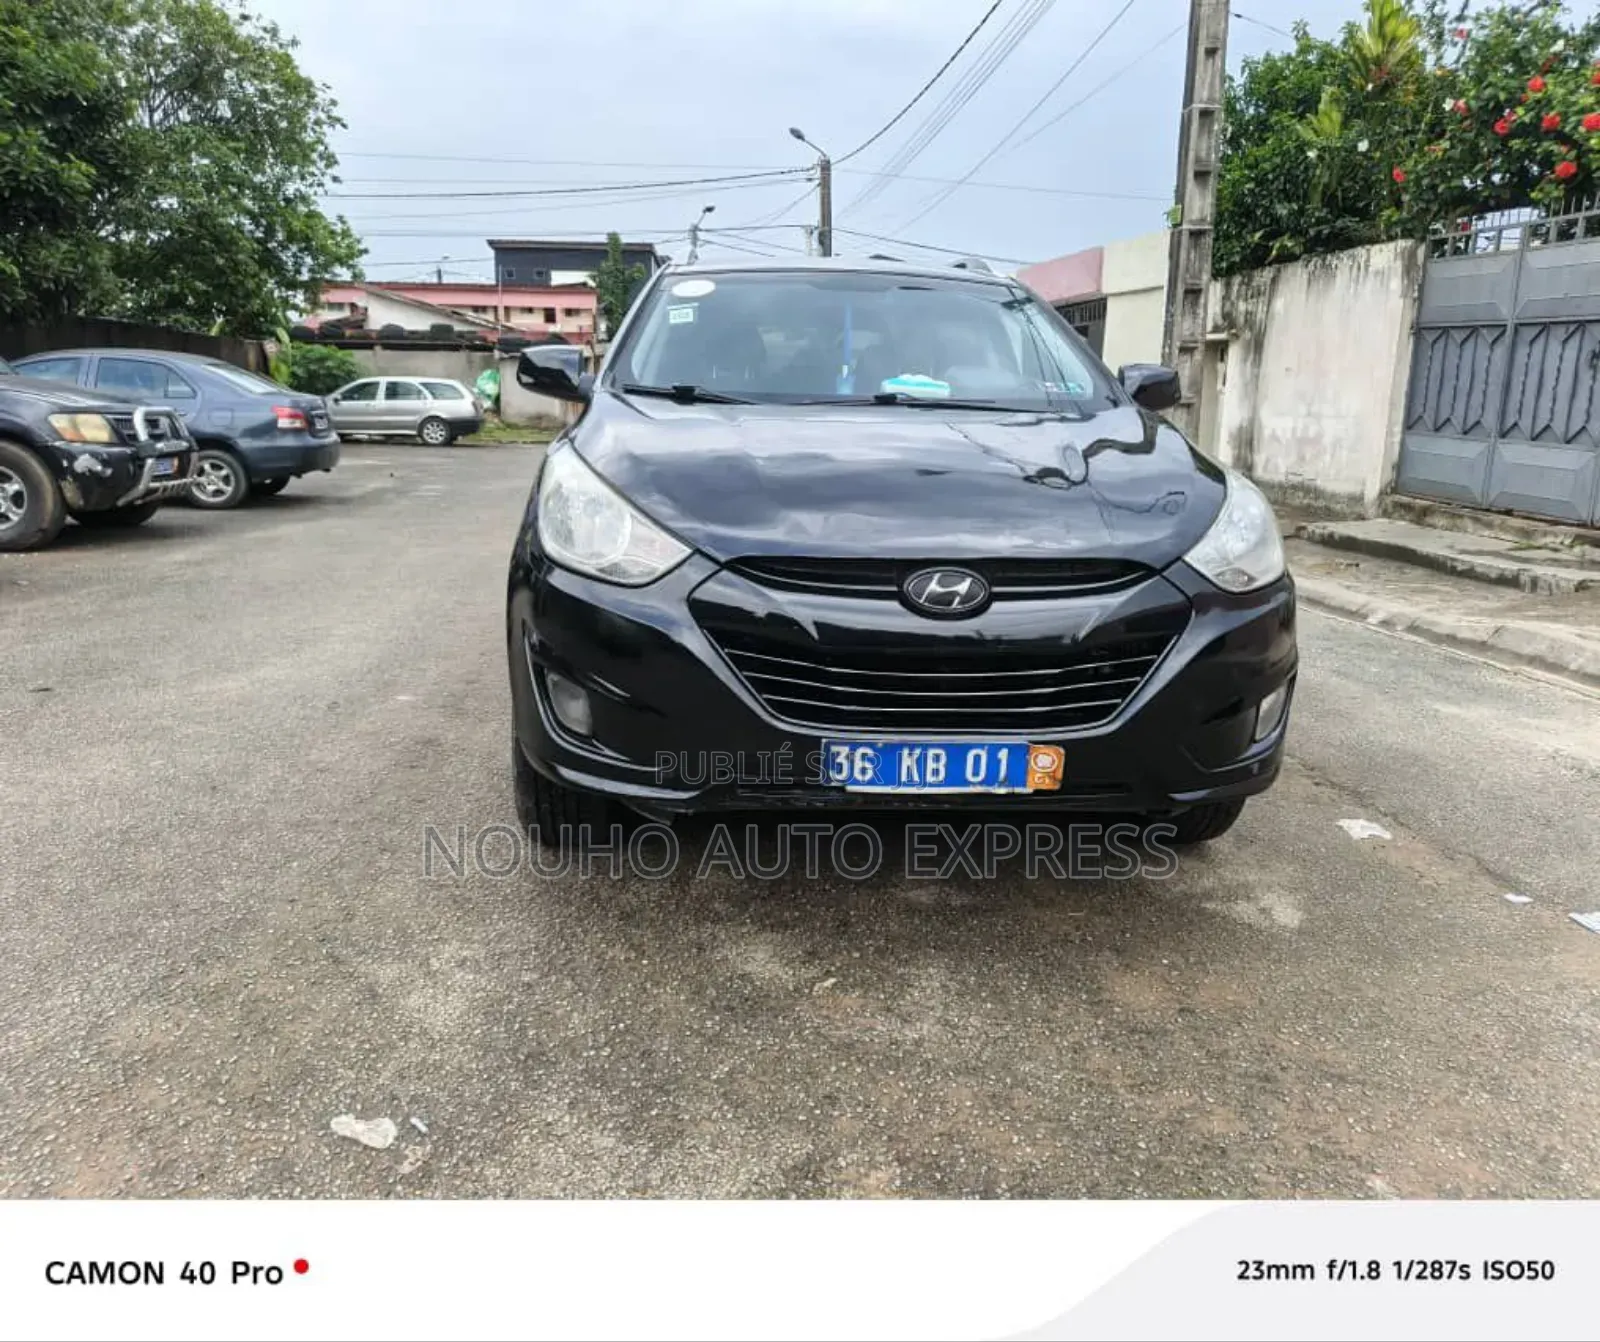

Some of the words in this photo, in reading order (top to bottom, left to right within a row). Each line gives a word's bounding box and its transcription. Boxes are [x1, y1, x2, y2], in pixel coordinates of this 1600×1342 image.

[829, 746, 875, 781] 36
[901, 747, 947, 783] KB
[965, 748, 1010, 782] 01
